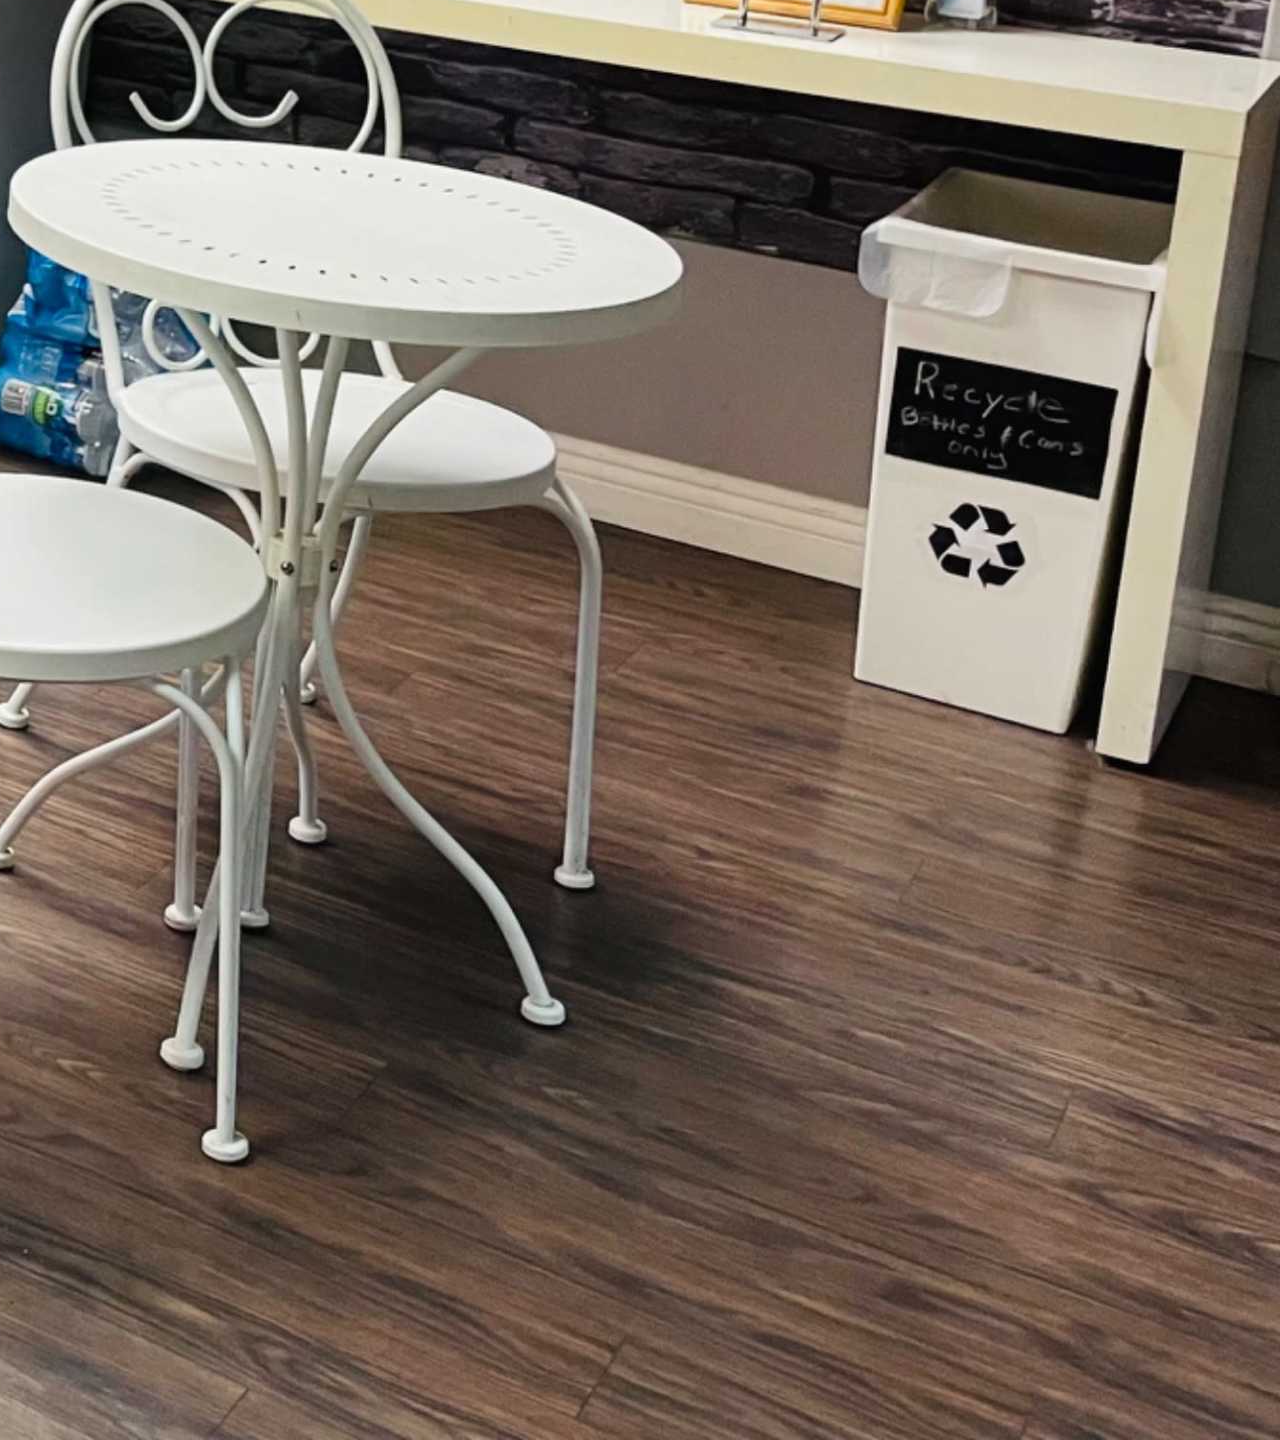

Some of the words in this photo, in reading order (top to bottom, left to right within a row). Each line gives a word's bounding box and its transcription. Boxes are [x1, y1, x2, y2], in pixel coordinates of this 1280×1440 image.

[914, 360, 1071, 425] Recycle
[900, 405, 987, 439] Bottles
[1018, 429, 1085, 458] Cans
